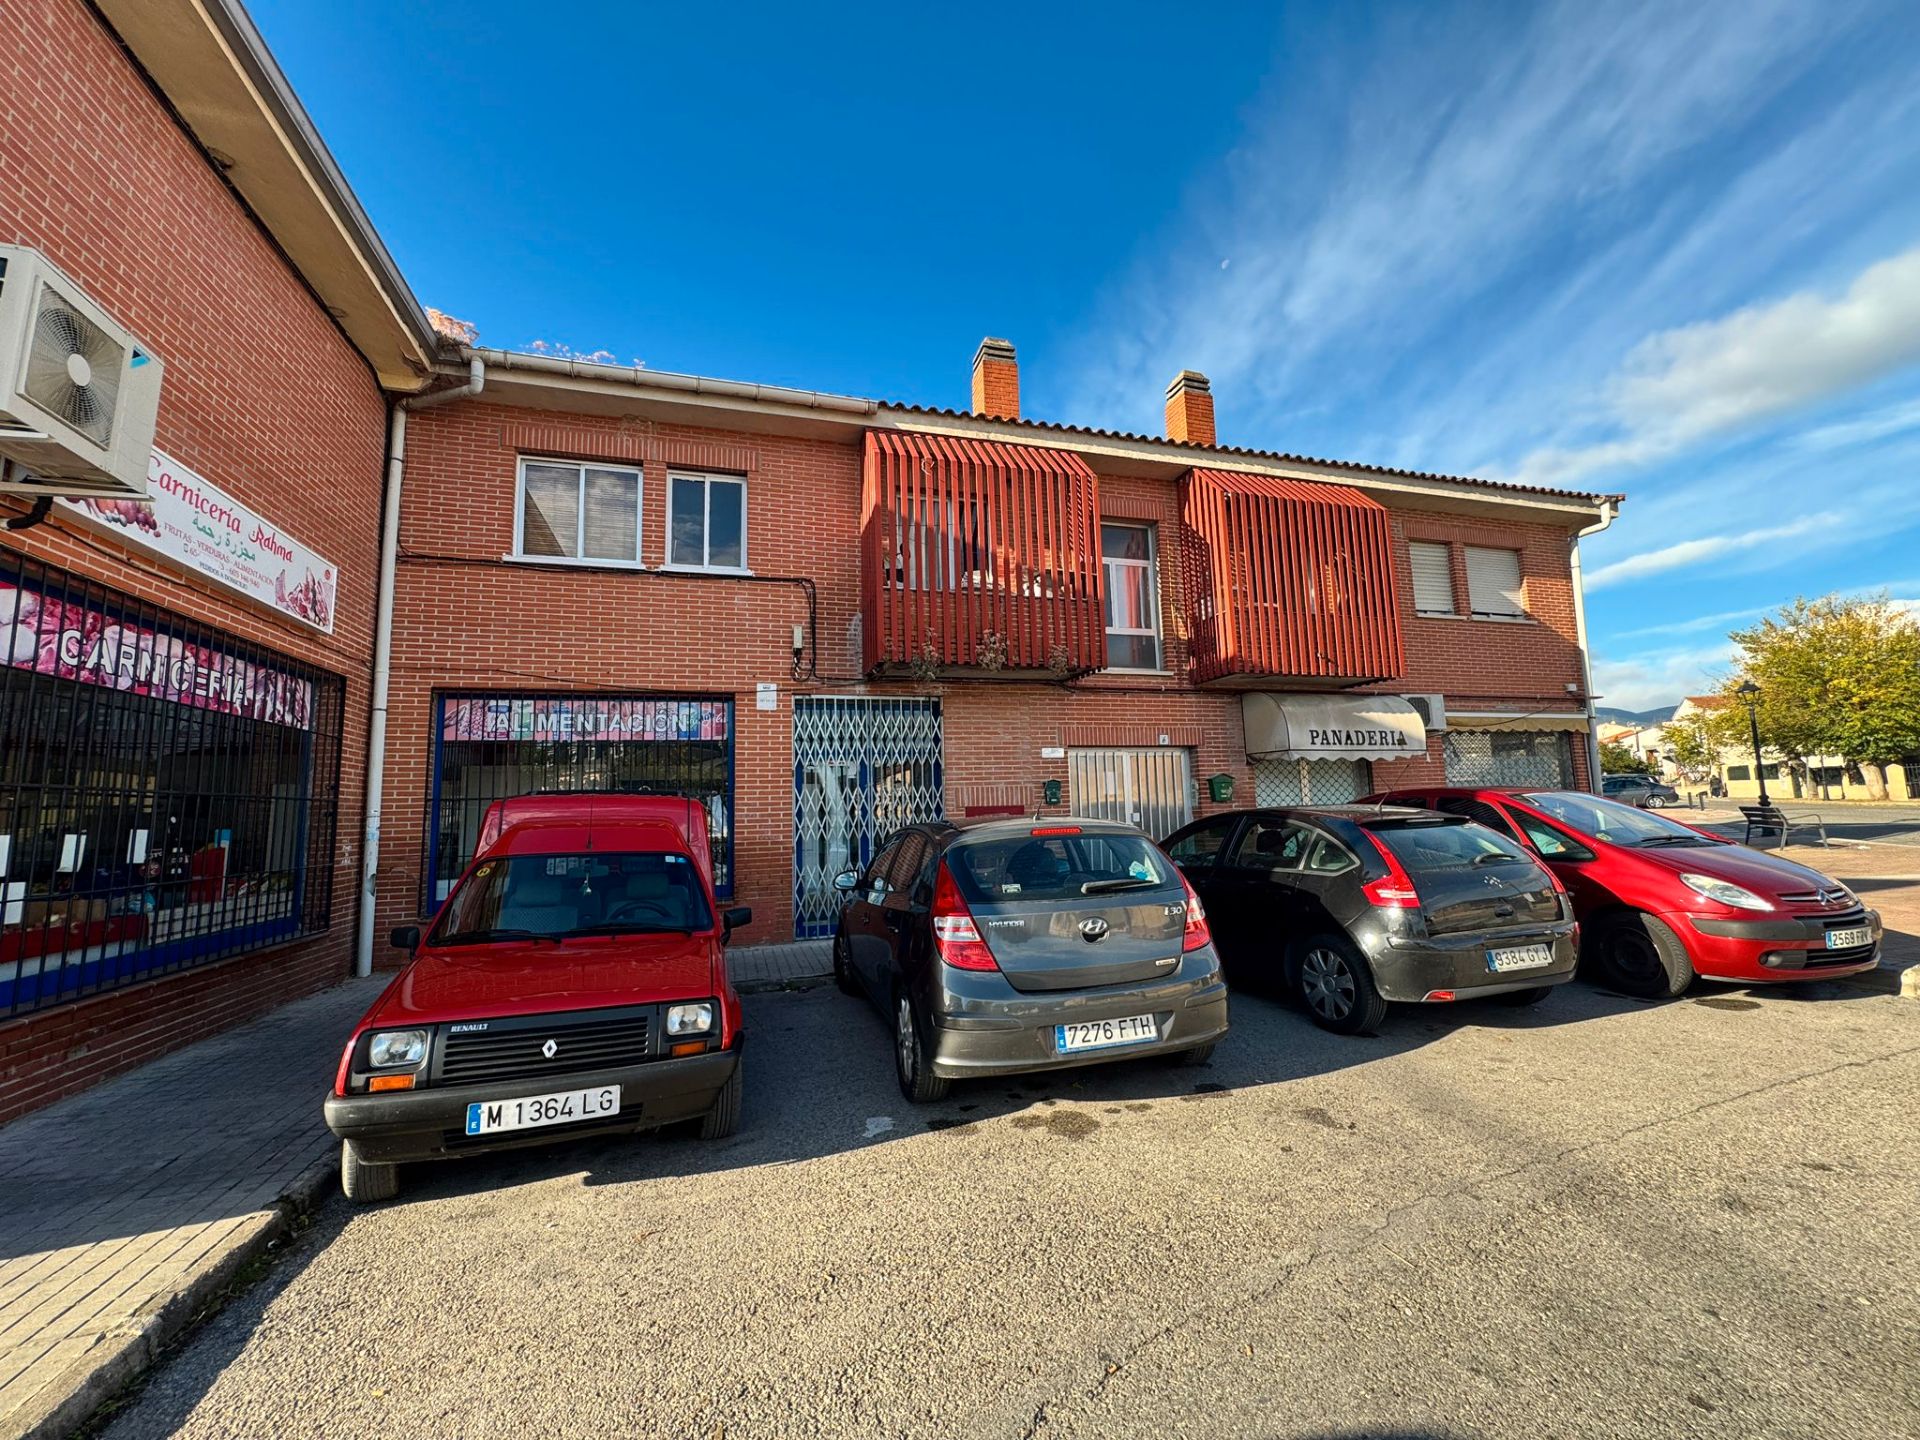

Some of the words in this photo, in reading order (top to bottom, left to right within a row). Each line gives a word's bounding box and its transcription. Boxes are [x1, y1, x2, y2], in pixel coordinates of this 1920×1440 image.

[147, 455, 241, 534] Carnicería
[248, 524, 293, 563] Rahma
[164, 522, 192, 545] FRUTAS
[192, 510, 222, 546] رحمة
[60, 629, 248, 706] CARNICERÍA
[492, 709, 688, 732] ALIMENTACIÓN
[1309, 729, 1408, 746] PANADERIA
[1832, 931, 1855, 947] 2569
[1495, 950, 1525, 967] 9384
[1526, 946, 1548, 962] GYJ
[450, 1023, 489, 1033] RENAULT
[1068, 1021, 1114, 1045] 7276
[1119, 1016, 1152, 1038] FTH
[487, 1103, 503, 1128] M
[516, 1096, 574, 1125] 1364
[582, 1090, 613, 1115] LG
